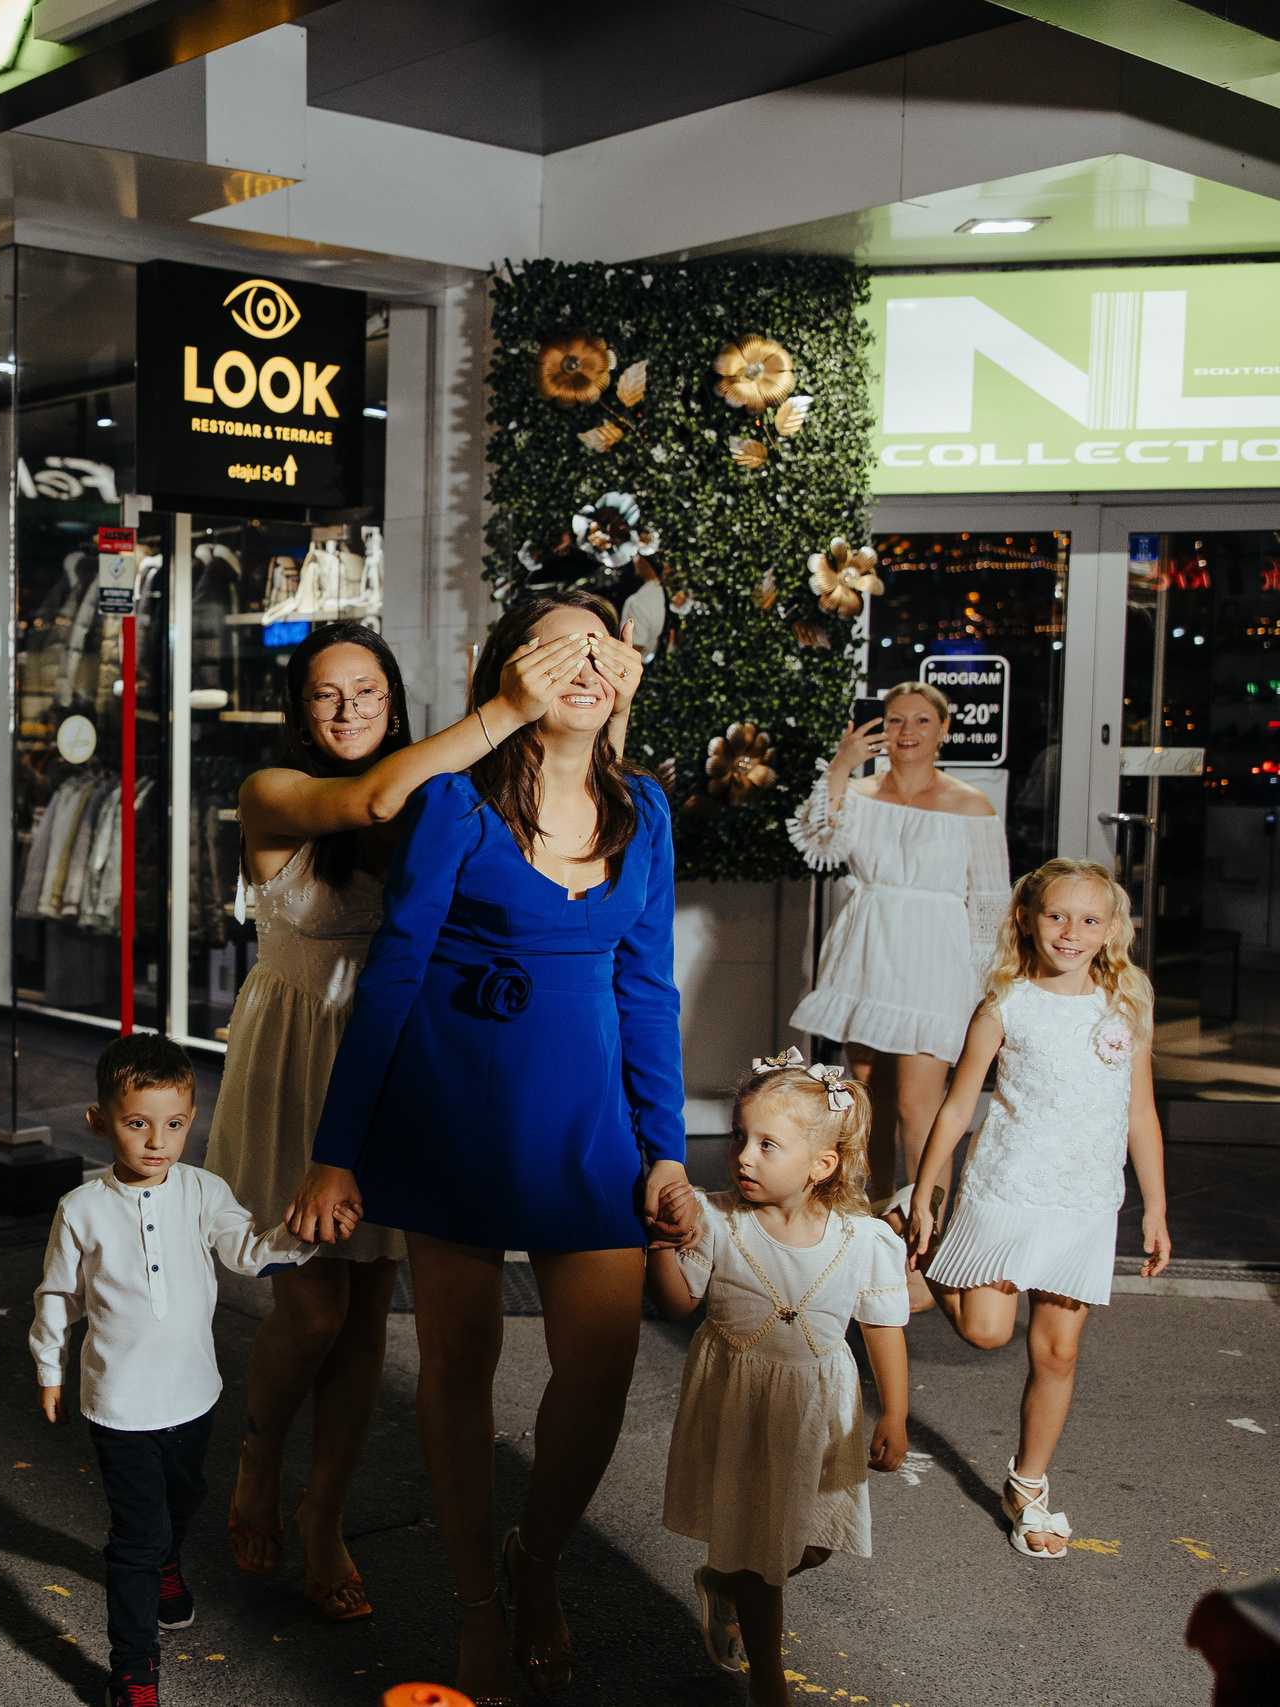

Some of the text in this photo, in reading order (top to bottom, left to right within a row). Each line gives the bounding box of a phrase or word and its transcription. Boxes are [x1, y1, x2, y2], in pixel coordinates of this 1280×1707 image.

[184, 345, 341, 418] LOOK
[191, 417, 333, 446] RESTOBAR & TERRACE
[880, 439, 1280, 467] COLLECTIO
[227, 463, 283, 483] etajul 5-6
[928, 672, 1001, 685] PROGRAM
